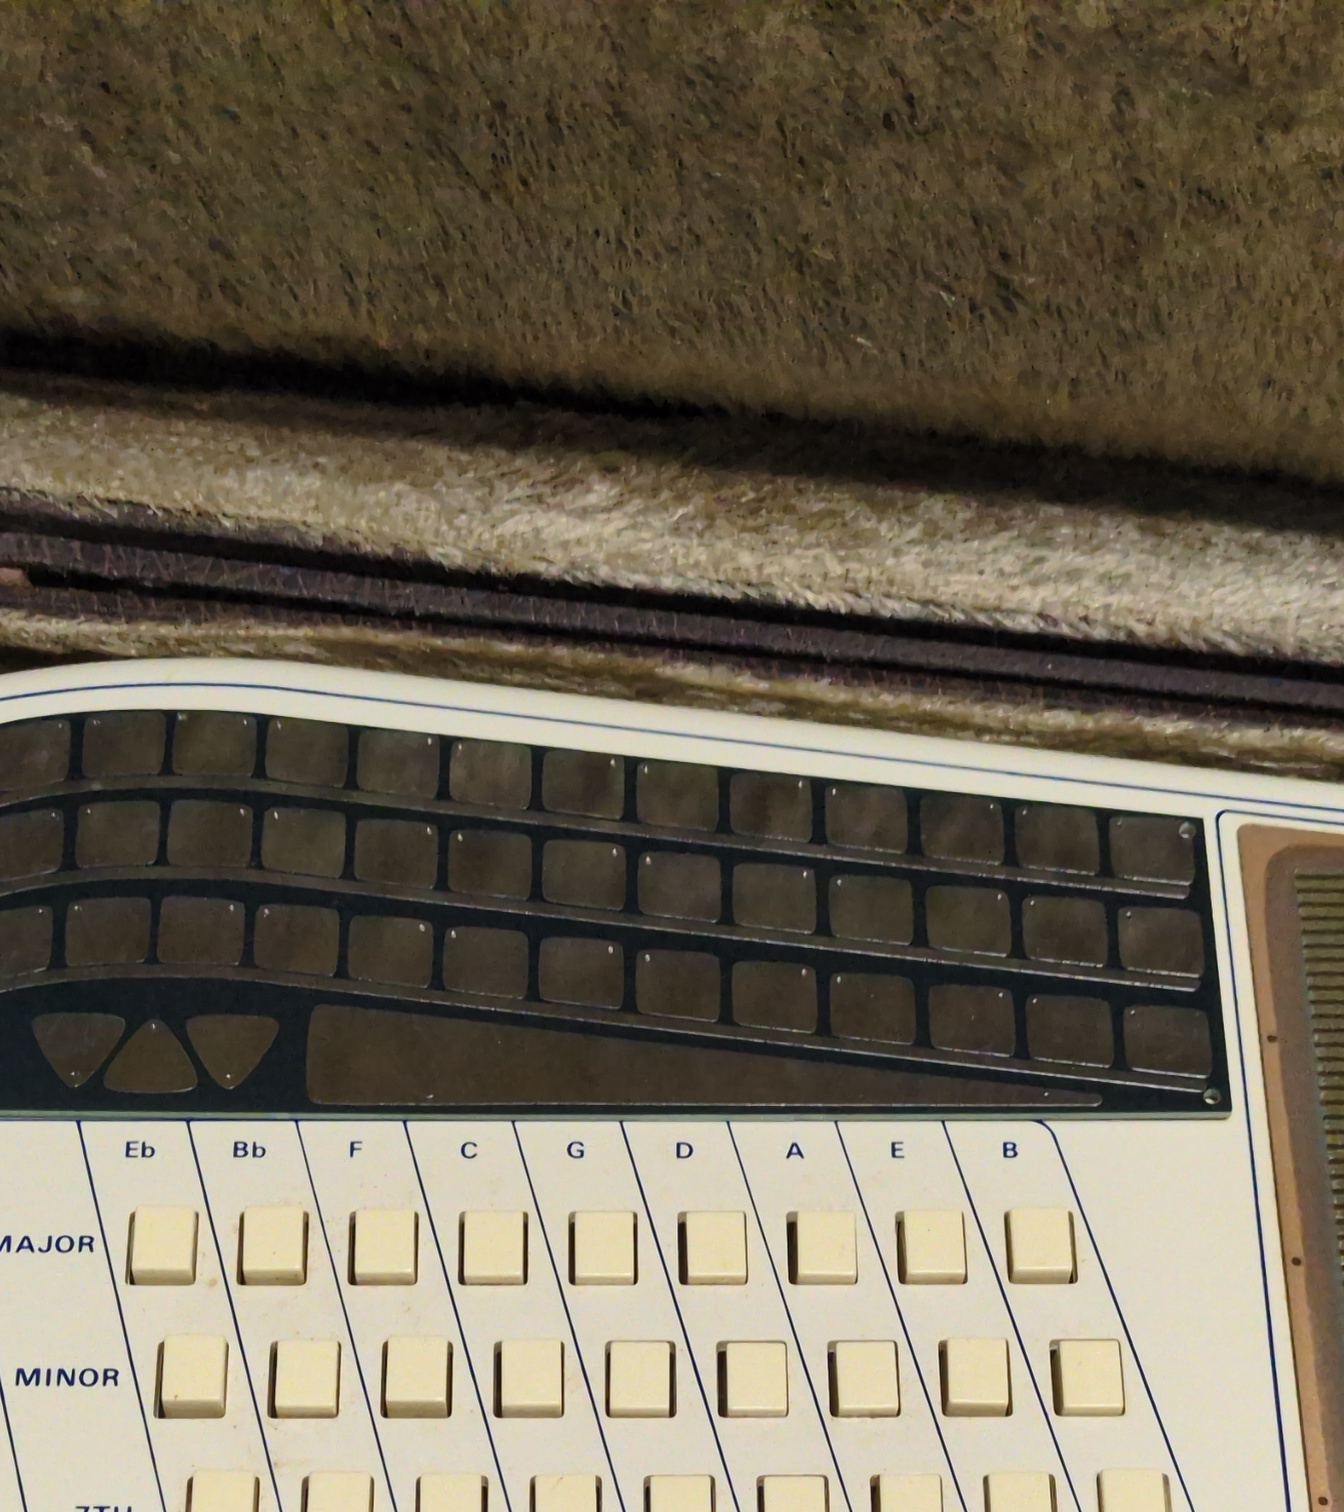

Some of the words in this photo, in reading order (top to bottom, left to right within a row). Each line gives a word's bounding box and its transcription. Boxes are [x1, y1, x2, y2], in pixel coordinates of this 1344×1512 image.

[124, 1140, 156, 1159] Eb
[232, 1140, 267, 1159] Bb
[349, 1140, 363, 1158] F
[460, 1141, 478, 1160] C
[566, 1141, 585, 1159] G
[675, 1141, 694, 1159] D
[785, 1142, 805, 1160] A
[890, 1141, 905, 1159] E
[1002, 1141, 1019, 1159] B
[15, 1367, 120, 1388] MINOR
